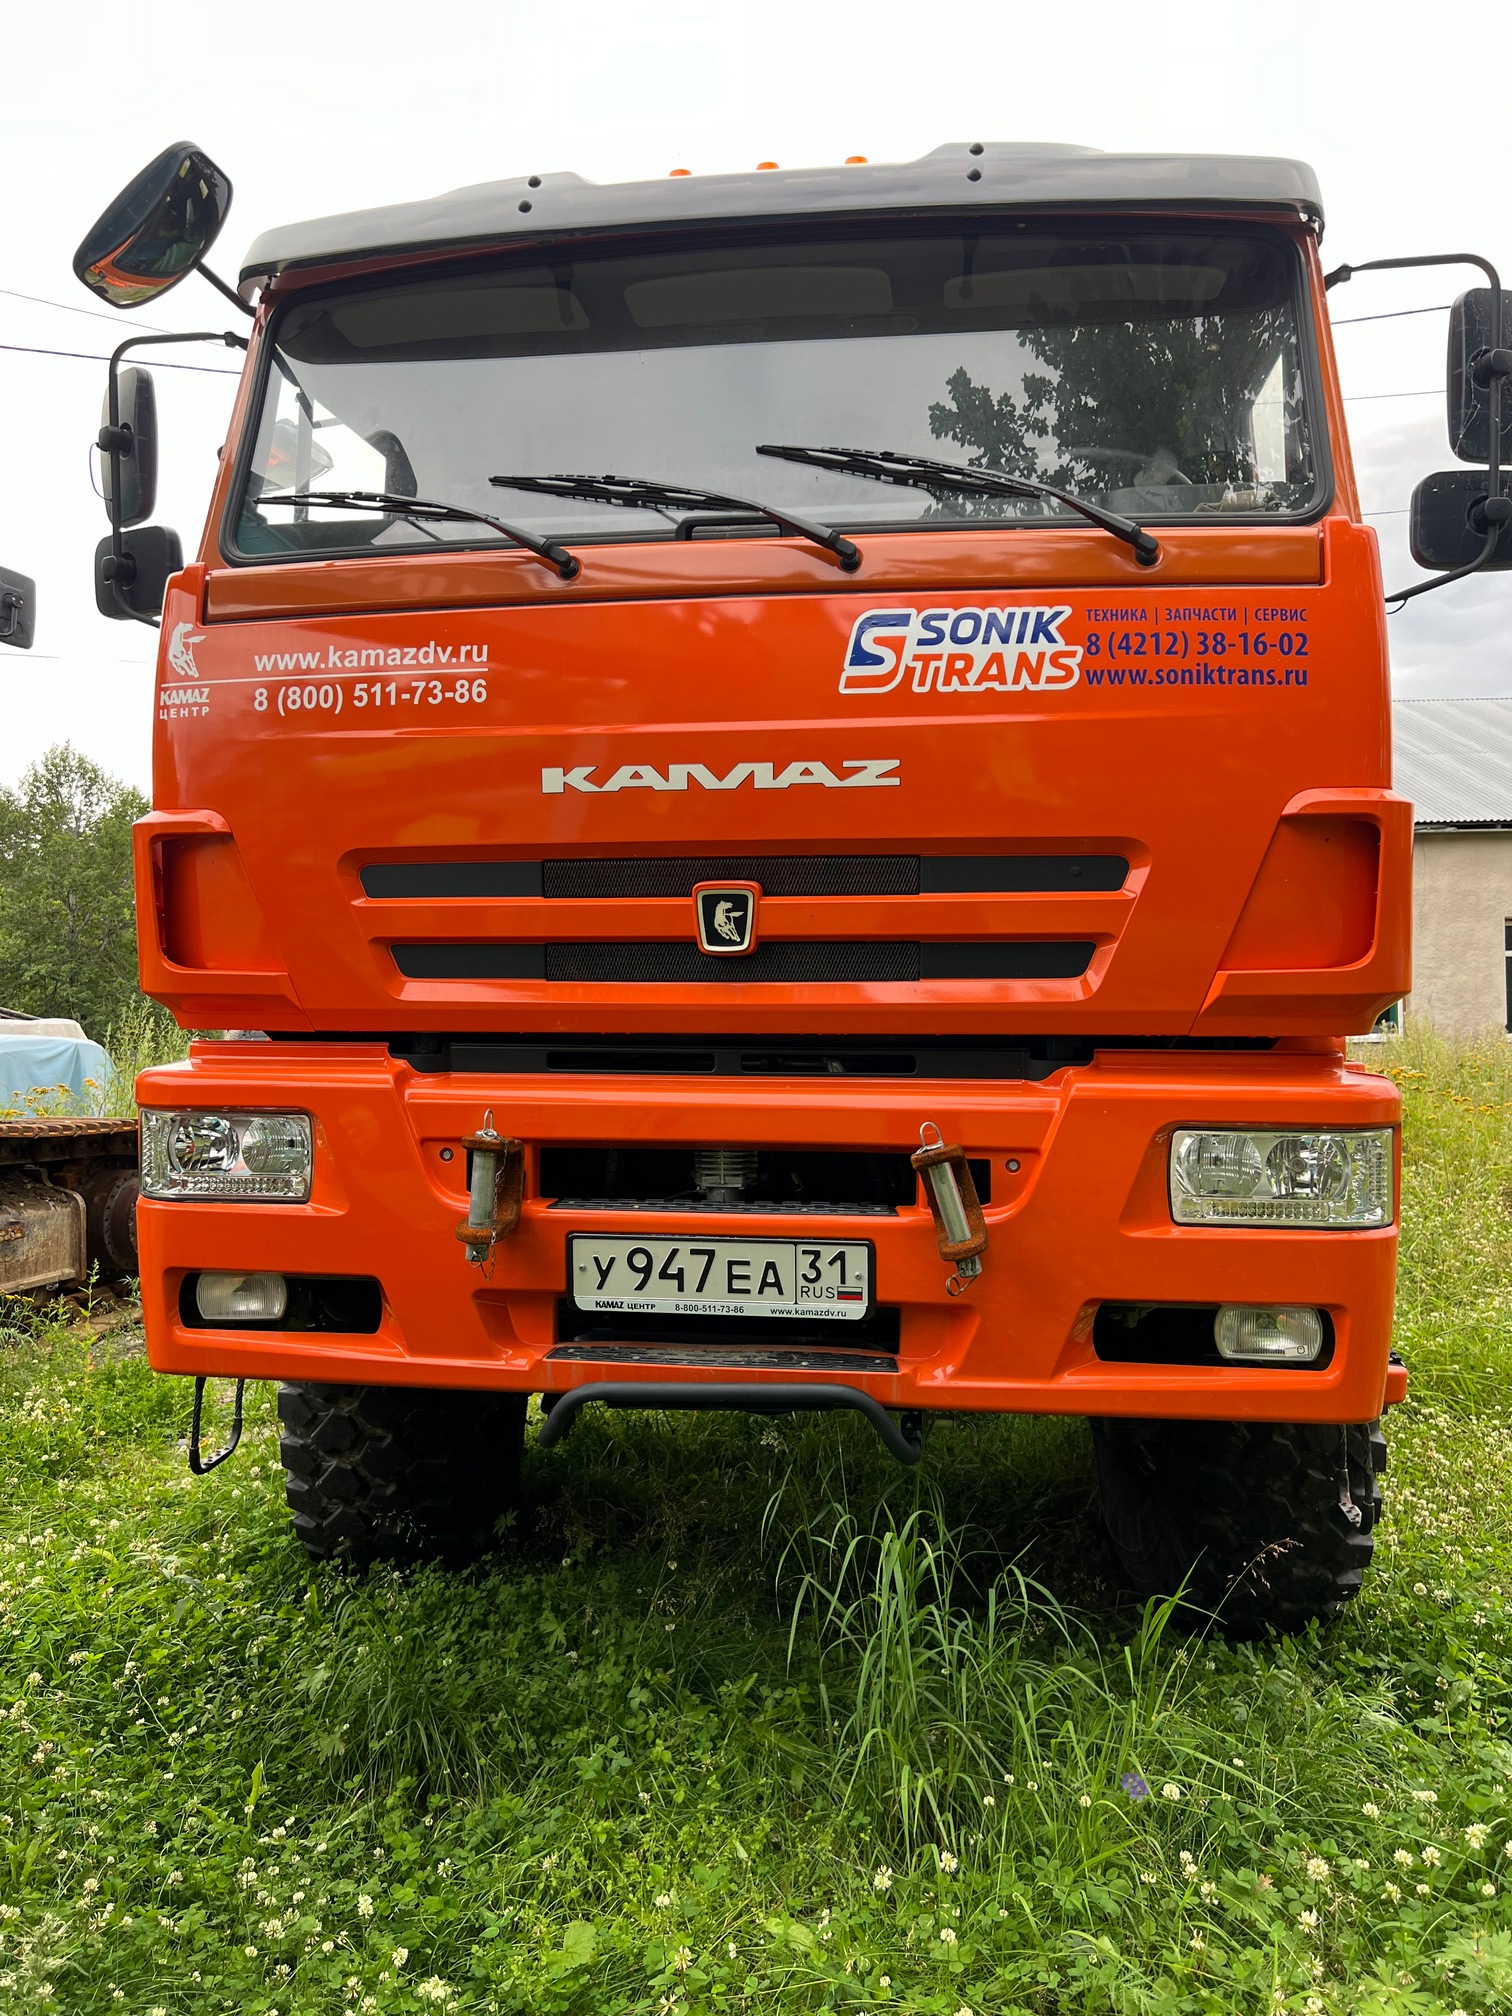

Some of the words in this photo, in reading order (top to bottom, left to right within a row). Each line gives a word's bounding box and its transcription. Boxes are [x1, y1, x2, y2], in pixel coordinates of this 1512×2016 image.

[1085, 607, 1148, 622] ТЕХНИКА
[1165, 607, 1237, 622] ЗАПЧАСТИ
[1254, 607, 1307, 622] СЕРВИС
[916, 610, 1066, 647] SONIK
[254, 641, 489, 671] www.kamazdv.ru
[1086, 632, 1101, 656] 8
[1108, 631, 1190, 659] (4212)
[1197, 632, 1308, 656] 38-16-02
[911, 650, 1080, 688] TRANS
[1085, 663, 1308, 686] www.soniktrans.ru
[159, 688, 210, 706] KAMAZ
[254, 688, 268, 711] 8
[277, 684, 344, 716] (800)
[353, 678, 488, 708] 511-73-86
[159, 705, 210, 720] ЦЕНТР
[541, 759, 901, 794] KAMAZ
[800, 1249, 847, 1285] 31
[800, 1286, 835, 1299] RUS
[595, 1301, 624, 1309] KAMAZ
[674, 1304, 745, 1315] 8-800-511-73-86
[770, 1307, 847, 1318] www.kamazdv.ru
